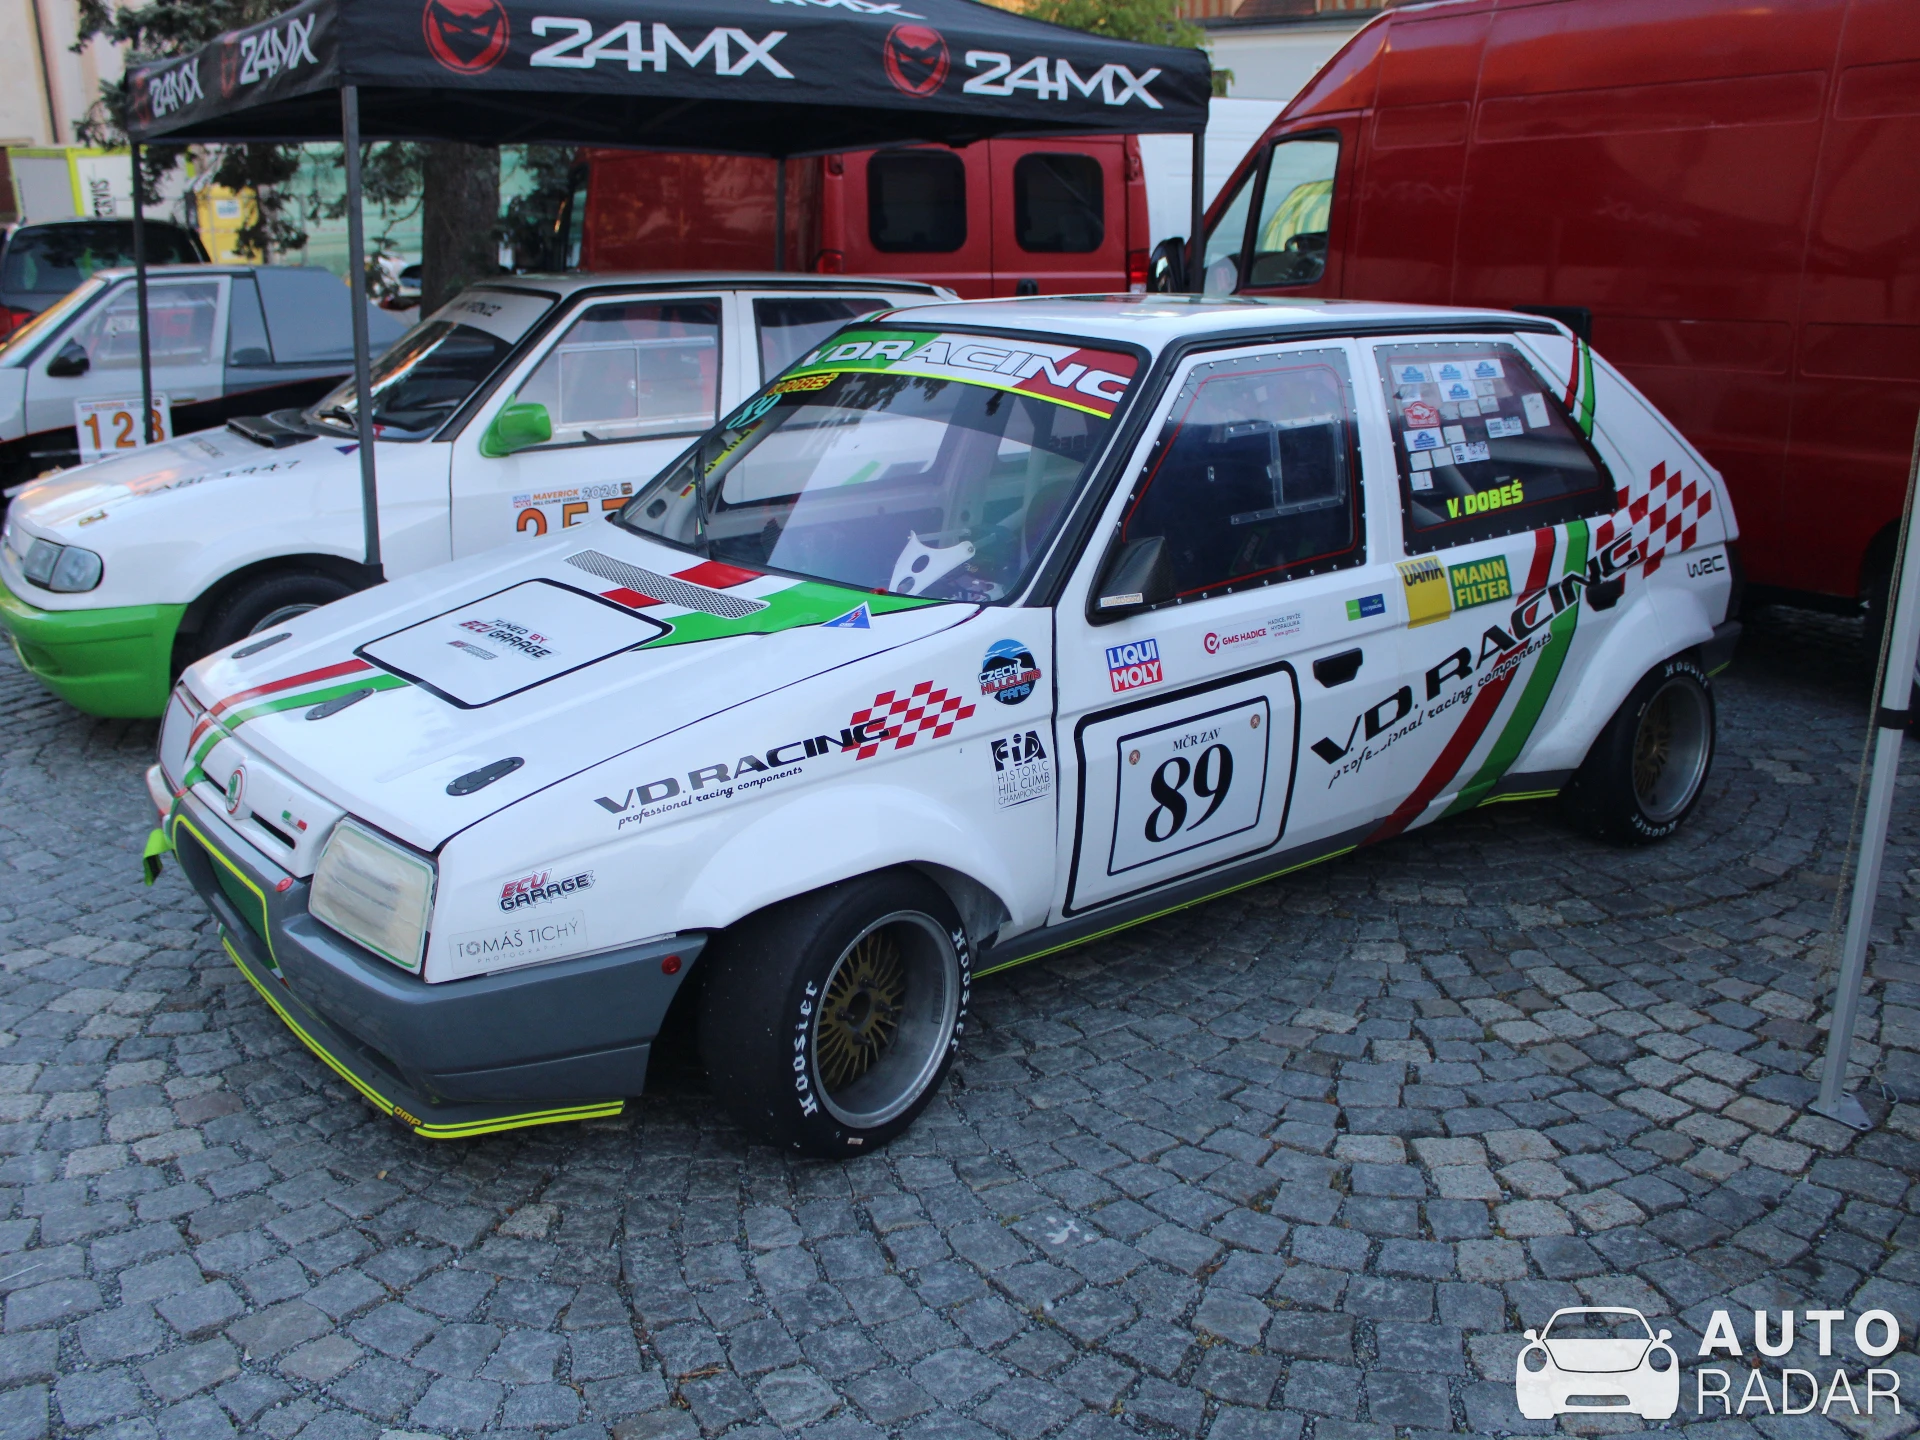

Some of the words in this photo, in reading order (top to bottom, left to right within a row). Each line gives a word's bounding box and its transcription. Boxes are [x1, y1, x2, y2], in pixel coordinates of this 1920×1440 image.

[240, 13, 319, 85] 24MX
[530, 16, 794, 79] 24MX
[149, 58, 204, 118] 24MX
[963, 50, 1163, 110] 24MX
[533, 488, 579, 501] MAVERICK
[1447, 498, 1462, 518] V.
[1465, 479, 1524, 515] DOBEŠ
[1453, 560, 1506, 587] MANN
[1686, 554, 1725, 578] WRC
[1456, 579, 1510, 607] FILTER
[459, 620, 497, 633] ECU
[489, 630, 551, 657] GARAGE
[490, 619, 528, 635] TUNED
[529, 633, 548, 644] BY
[1222, 634, 1239, 645] GMS
[1240, 628, 1267, 641] HADICE
[1106, 640, 1158, 669] LIQUI
[978, 664, 1018, 684] CZECH
[1112, 661, 1162, 691] MOLY
[1328, 709, 1424, 789] profeional
[1427, 684, 1472, 718] racing
[1477, 631, 1552, 688] components
[1173, 734, 1198, 751] MČR
[1200, 728, 1221, 743] ZAV
[997, 760, 1050, 784] HISTORIC
[998, 781, 1018, 796] HILL
[1020, 771, 1050, 789] CLIMB
[618, 795, 692, 830] professional
[696, 784, 734, 803] racing
[737, 766, 803, 789] components
[998, 782, 1051, 805] CHAMPIONSHIP
[1144, 743, 1234, 843] 89
[501, 872, 547, 898] ECU
[501, 874, 589, 911] GARAGE
[457, 929, 523, 958] TOMÁŠ
[528, 916, 578, 943] TICHÝ
[951, 927, 972, 1051] Hoosier
[792, 980, 819, 1118] Hoosier
